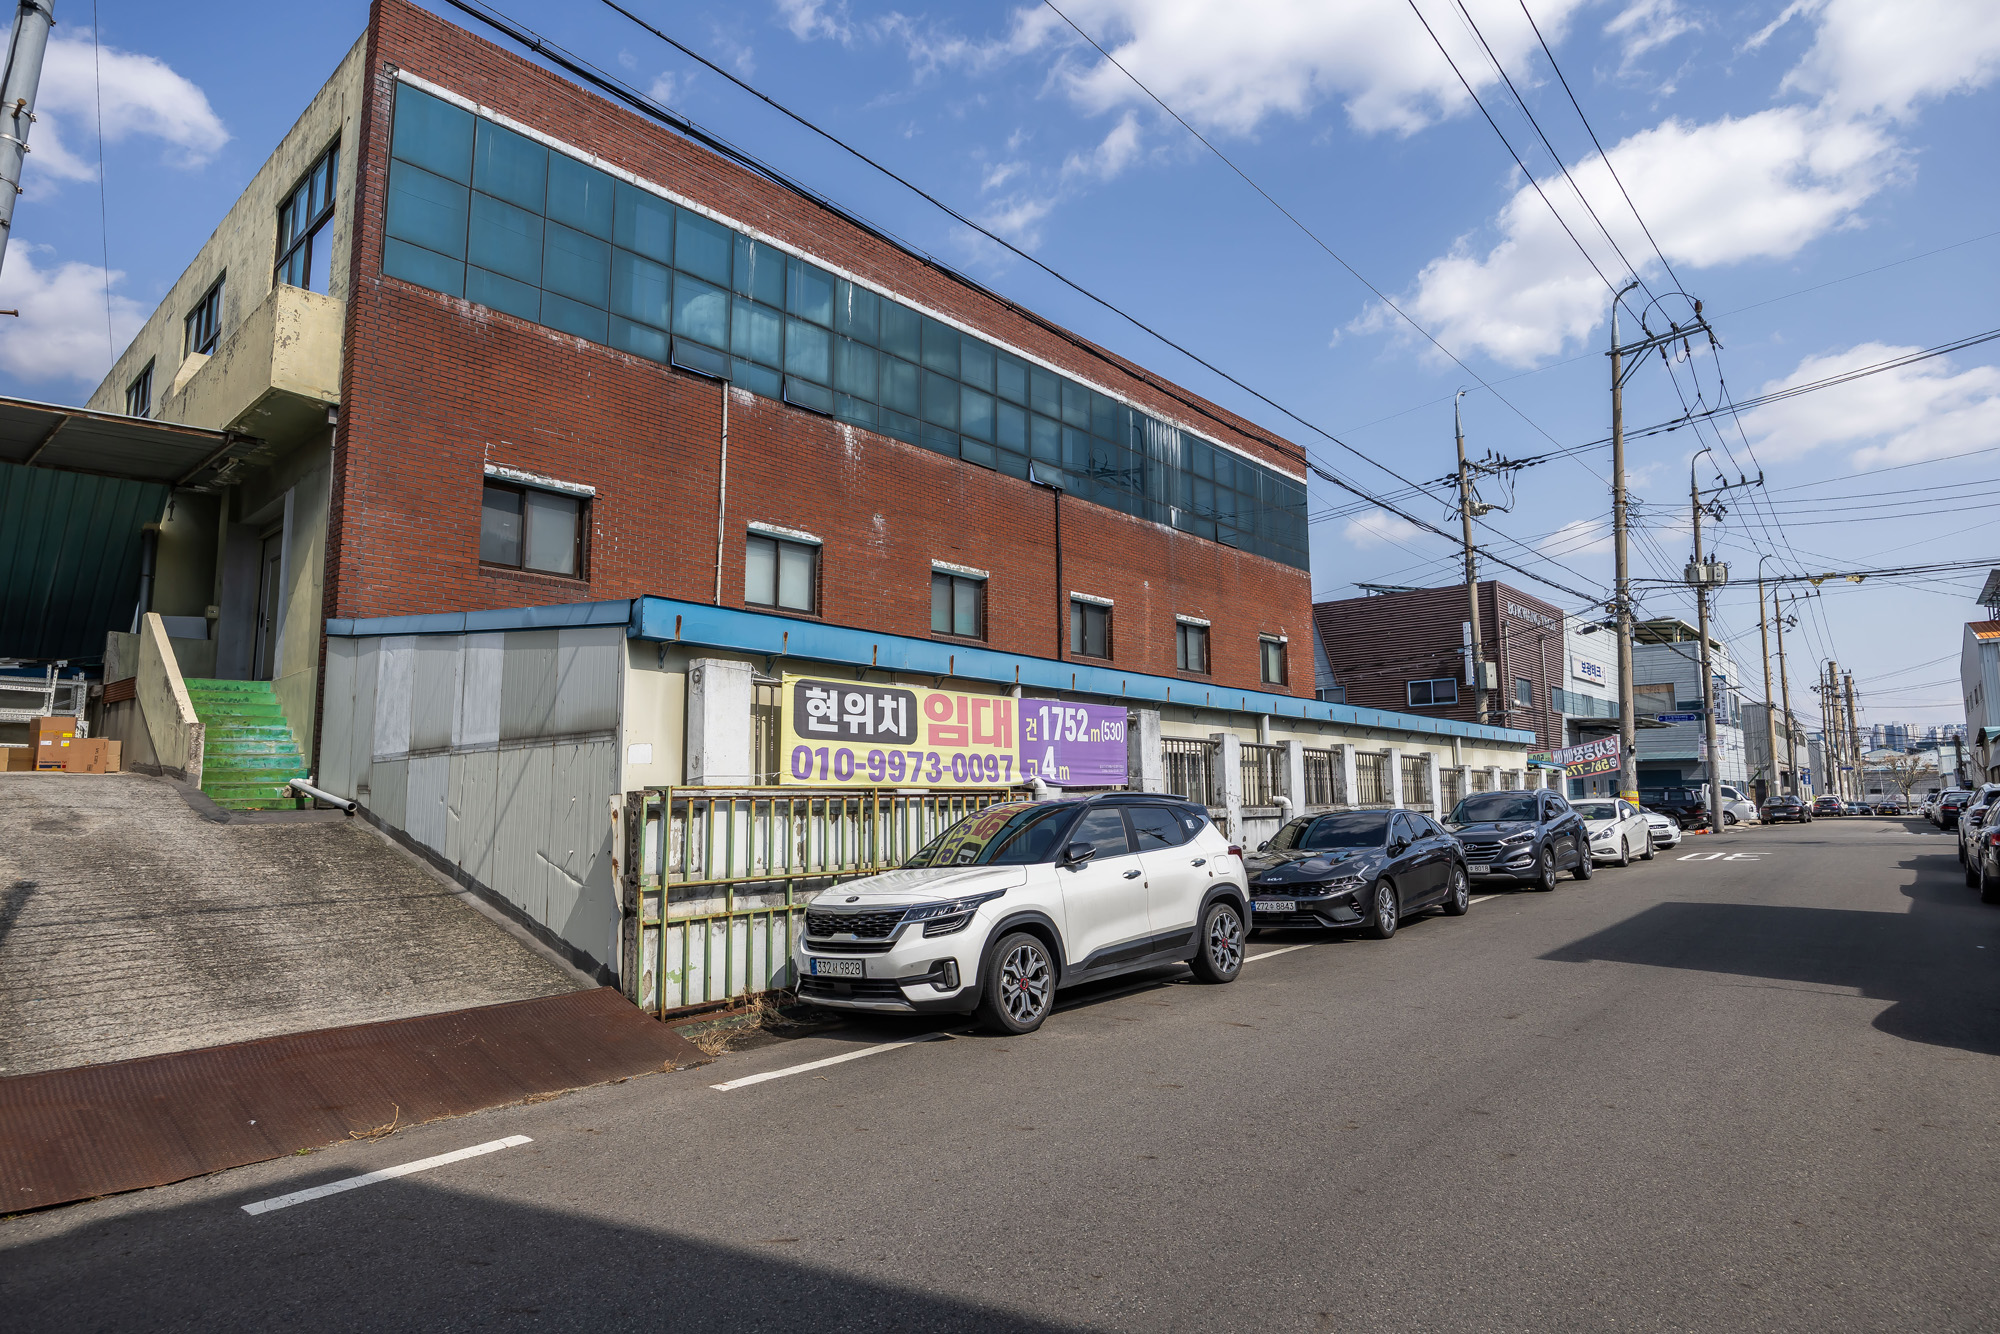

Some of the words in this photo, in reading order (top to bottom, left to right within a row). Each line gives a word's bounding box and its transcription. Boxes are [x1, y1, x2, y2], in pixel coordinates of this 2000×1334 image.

[1581, 661, 1602, 678] 보광테크
[805, 686, 907, 737] 현위치
[923, 693, 1013, 748] 임대
[790, 744, 1014, 783] 010-9973-0097
[839, 961, 861, 975] 9828
